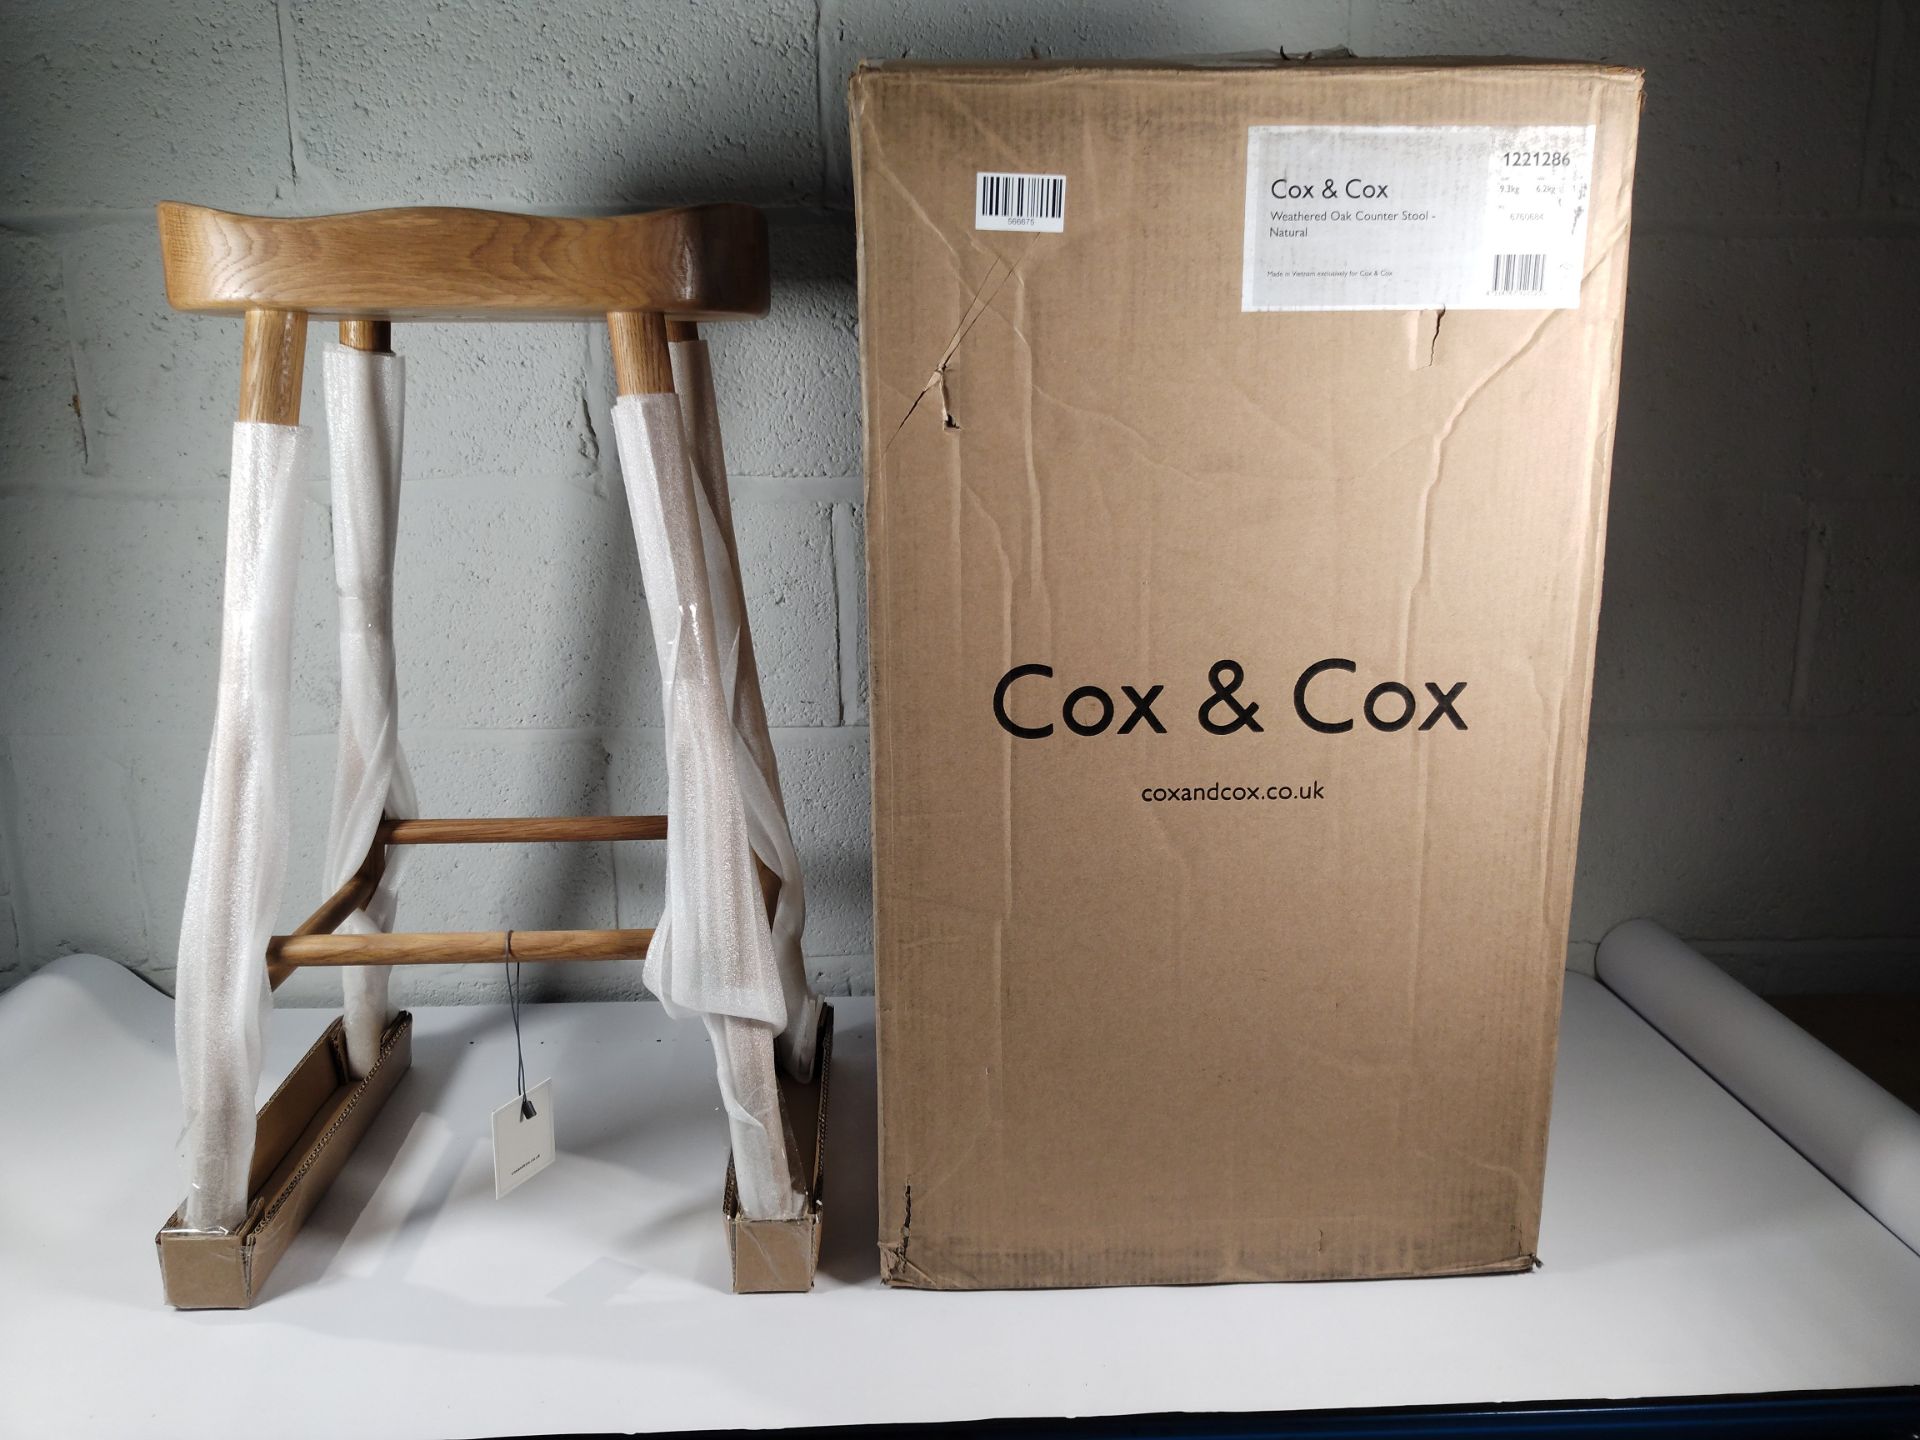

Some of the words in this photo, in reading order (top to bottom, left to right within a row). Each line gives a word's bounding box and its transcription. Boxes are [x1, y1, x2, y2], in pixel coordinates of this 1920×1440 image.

[1503, 152, 1571, 167] 1221286
[1271, 178, 1314, 199] Cox
[1321, 178, 1338, 199] &
[1345, 178, 1389, 199] Cox
[1270, 210, 1327, 222] Weathered
[1330, 210, 1352, 222] Oak
[1355, 210, 1399, 222] Counter
[1401, 210, 1429, 221] Stool
[1269, 227, 1308, 238] Natural
[1317, 270, 1348, 279] exclusively
[992, 662, 1168, 739] Cox
[1197, 659, 1265, 736] &
[1293, 657, 1468, 735] Cox
[1141, 780, 1325, 803] coxandcox.co.uk
